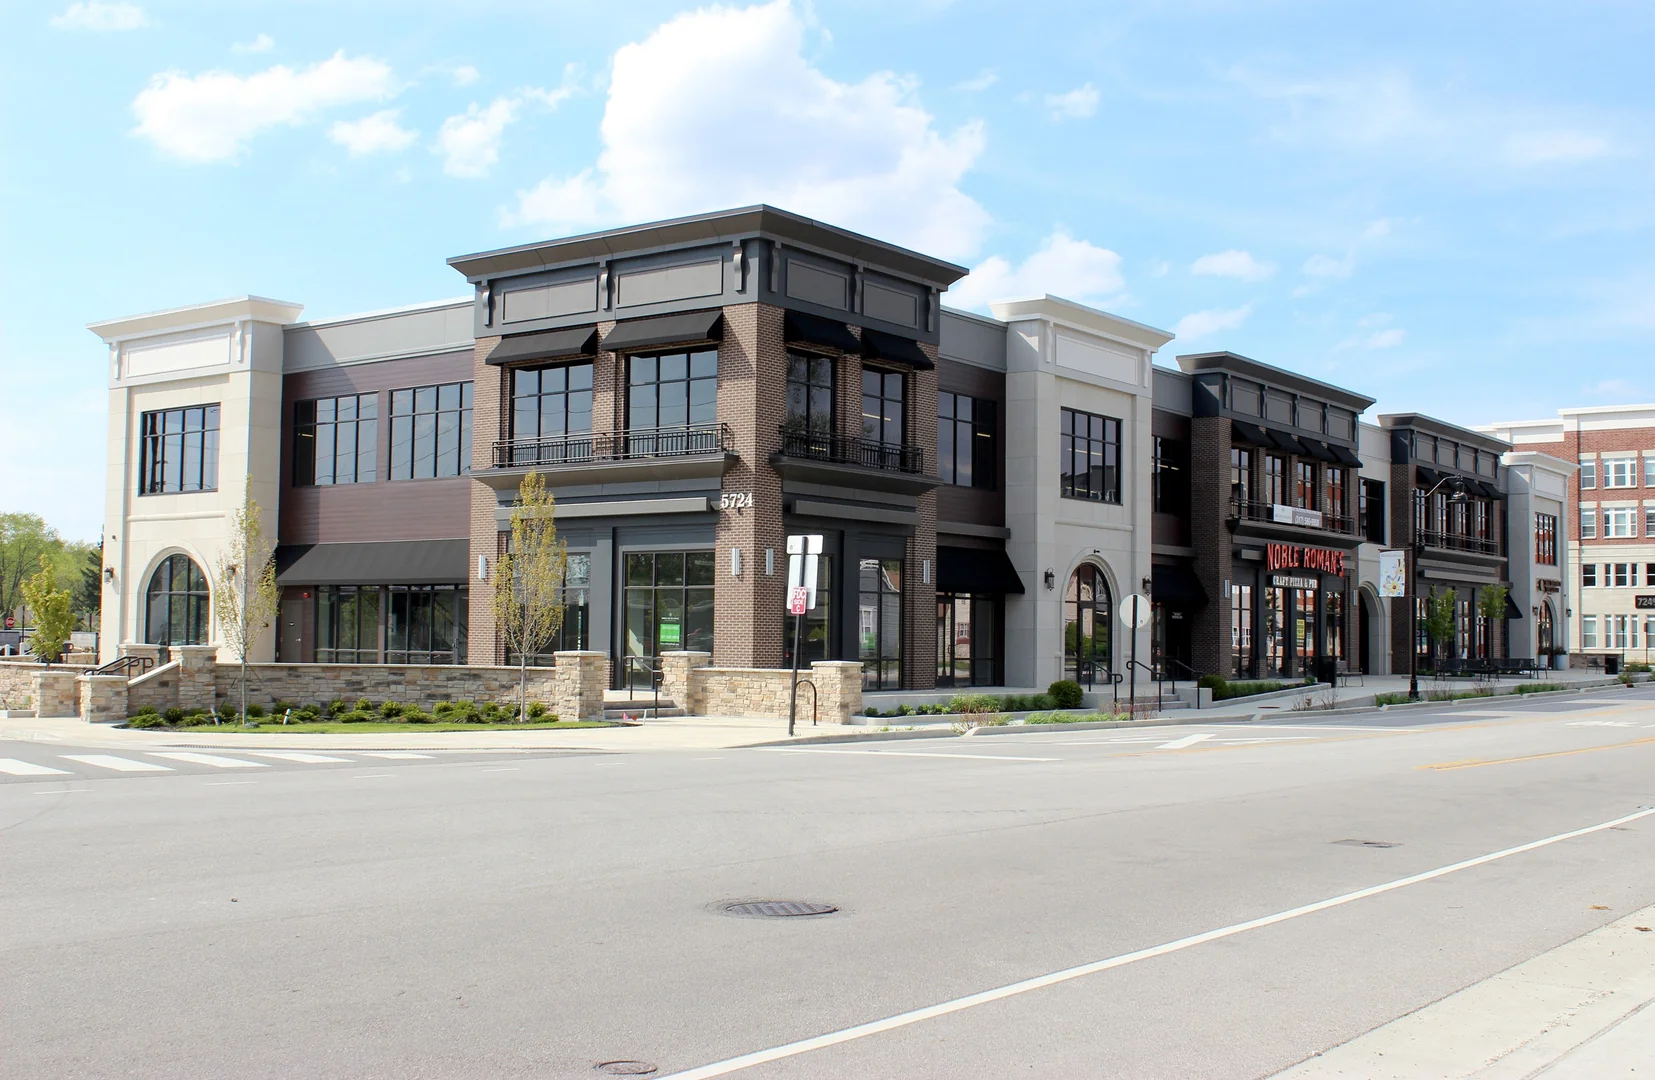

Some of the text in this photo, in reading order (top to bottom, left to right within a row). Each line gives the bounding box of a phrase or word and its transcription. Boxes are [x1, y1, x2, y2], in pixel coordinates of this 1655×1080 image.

[721, 492, 753, 508] 5724
[1267, 543, 1345, 578] NOBLE ROMAN'S
[1272, 575, 1289, 586] CRAFT
[1290, 577, 1303, 588] PIZZA
[1308, 579, 1318, 589] PUB
[793, 589, 806, 599] FDC
